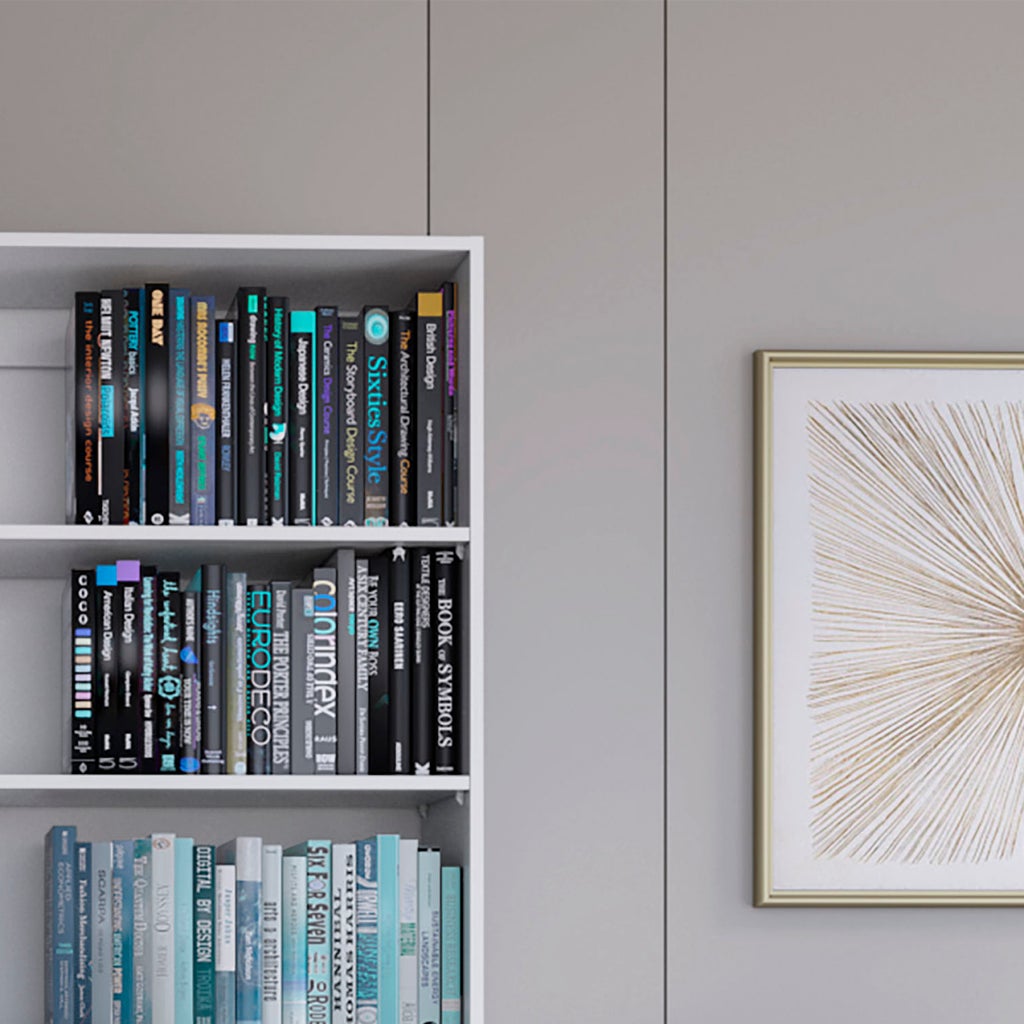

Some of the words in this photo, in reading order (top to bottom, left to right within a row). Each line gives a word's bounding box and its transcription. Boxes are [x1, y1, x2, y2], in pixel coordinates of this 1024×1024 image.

[101, 298, 112, 336] HELMUT
[151, 289, 164, 317] ONE
[84, 320, 93, 340] the
[128, 310, 139, 350] POTTERY
[151, 319, 164, 346] DAY
[271, 308, 282, 339] History
[323, 324, 332, 339] The
[401, 329, 411, 349] The
[425, 323, 437, 353] British
[101, 339, 112, 379] NEWTON
[274, 340, 282, 350] of
[296, 337, 309, 381] Japanese
[323, 340, 333, 376] Ceramics
[347, 342, 358, 363] The
[84, 344, 94, 391] interior
[129, 351, 139, 375] basics
[274, 351, 282, 384] Modern
[423, 355, 437, 389] Design
[296, 383, 309, 415] Design
[321, 377, 332, 404] Design
[344, 364, 358, 425] Storyboard
[367, 356, 388, 428] Sixties
[400, 351, 411, 414] Architectural
[81, 395, 94, 436] design
[271, 386, 282, 416] Design
[323, 405, 332, 434] Course
[397, 416, 411, 457] Drawing
[84, 440, 93, 482] course
[344, 427, 358, 463] Design
[364, 430, 388, 484] Style
[347, 465, 358, 504] Course
[400, 459, 411, 494] Course
[357, 565, 368, 574] A
[357, 575, 368, 592] SIX
[420, 555, 430, 584] TEXTILE
[78, 575, 89, 625] COCO
[124, 587, 135, 611] Italian
[275, 590, 287, 607] David
[438, 579, 446, 596] THE
[102, 590, 113, 630] American
[202, 590, 222, 644] Hindsights
[357, 595, 368, 648] CENTURY
[393, 602, 404, 624] EERO
[420, 586, 430, 628] DESIGNERS
[438, 599, 453, 647] BOOK
[122, 613, 135, 643] Design
[273, 631, 289, 654] THE
[368, 619, 379, 648] OWN
[100, 632, 113, 661] Design
[393, 626, 404, 669] SAARINEN
[438, 649, 446, 661] OF
[250, 591, 272, 746] EURODECO
[273, 656, 289, 699] PORTER
[357, 650, 368, 691] FAMILY
[437, 663, 453, 747] SYMBOLS
[134, 856, 147, 876] THE
[196, 846, 211, 892] DIGITAL
[57, 862, 65, 934] ECONOMETRICS
[79, 880, 88, 913] Fashion
[97, 869, 107, 924] SCARPA
[133, 879, 147, 921] QUANTUM
[196, 899, 211, 913] BY
[223, 888, 232, 915] Jasper
[264, 902, 278, 921] arts
[346, 855, 354, 943] HARRIS
[77, 915, 88, 979] Merchandising
[134, 922, 147, 956] DOCTOR
[196, 919, 211, 962] DESIGN
[224, 919, 232, 944] Johns
[264, 938, 279, 1002] architecture
[196, 969, 211, 1010] TROIKA
